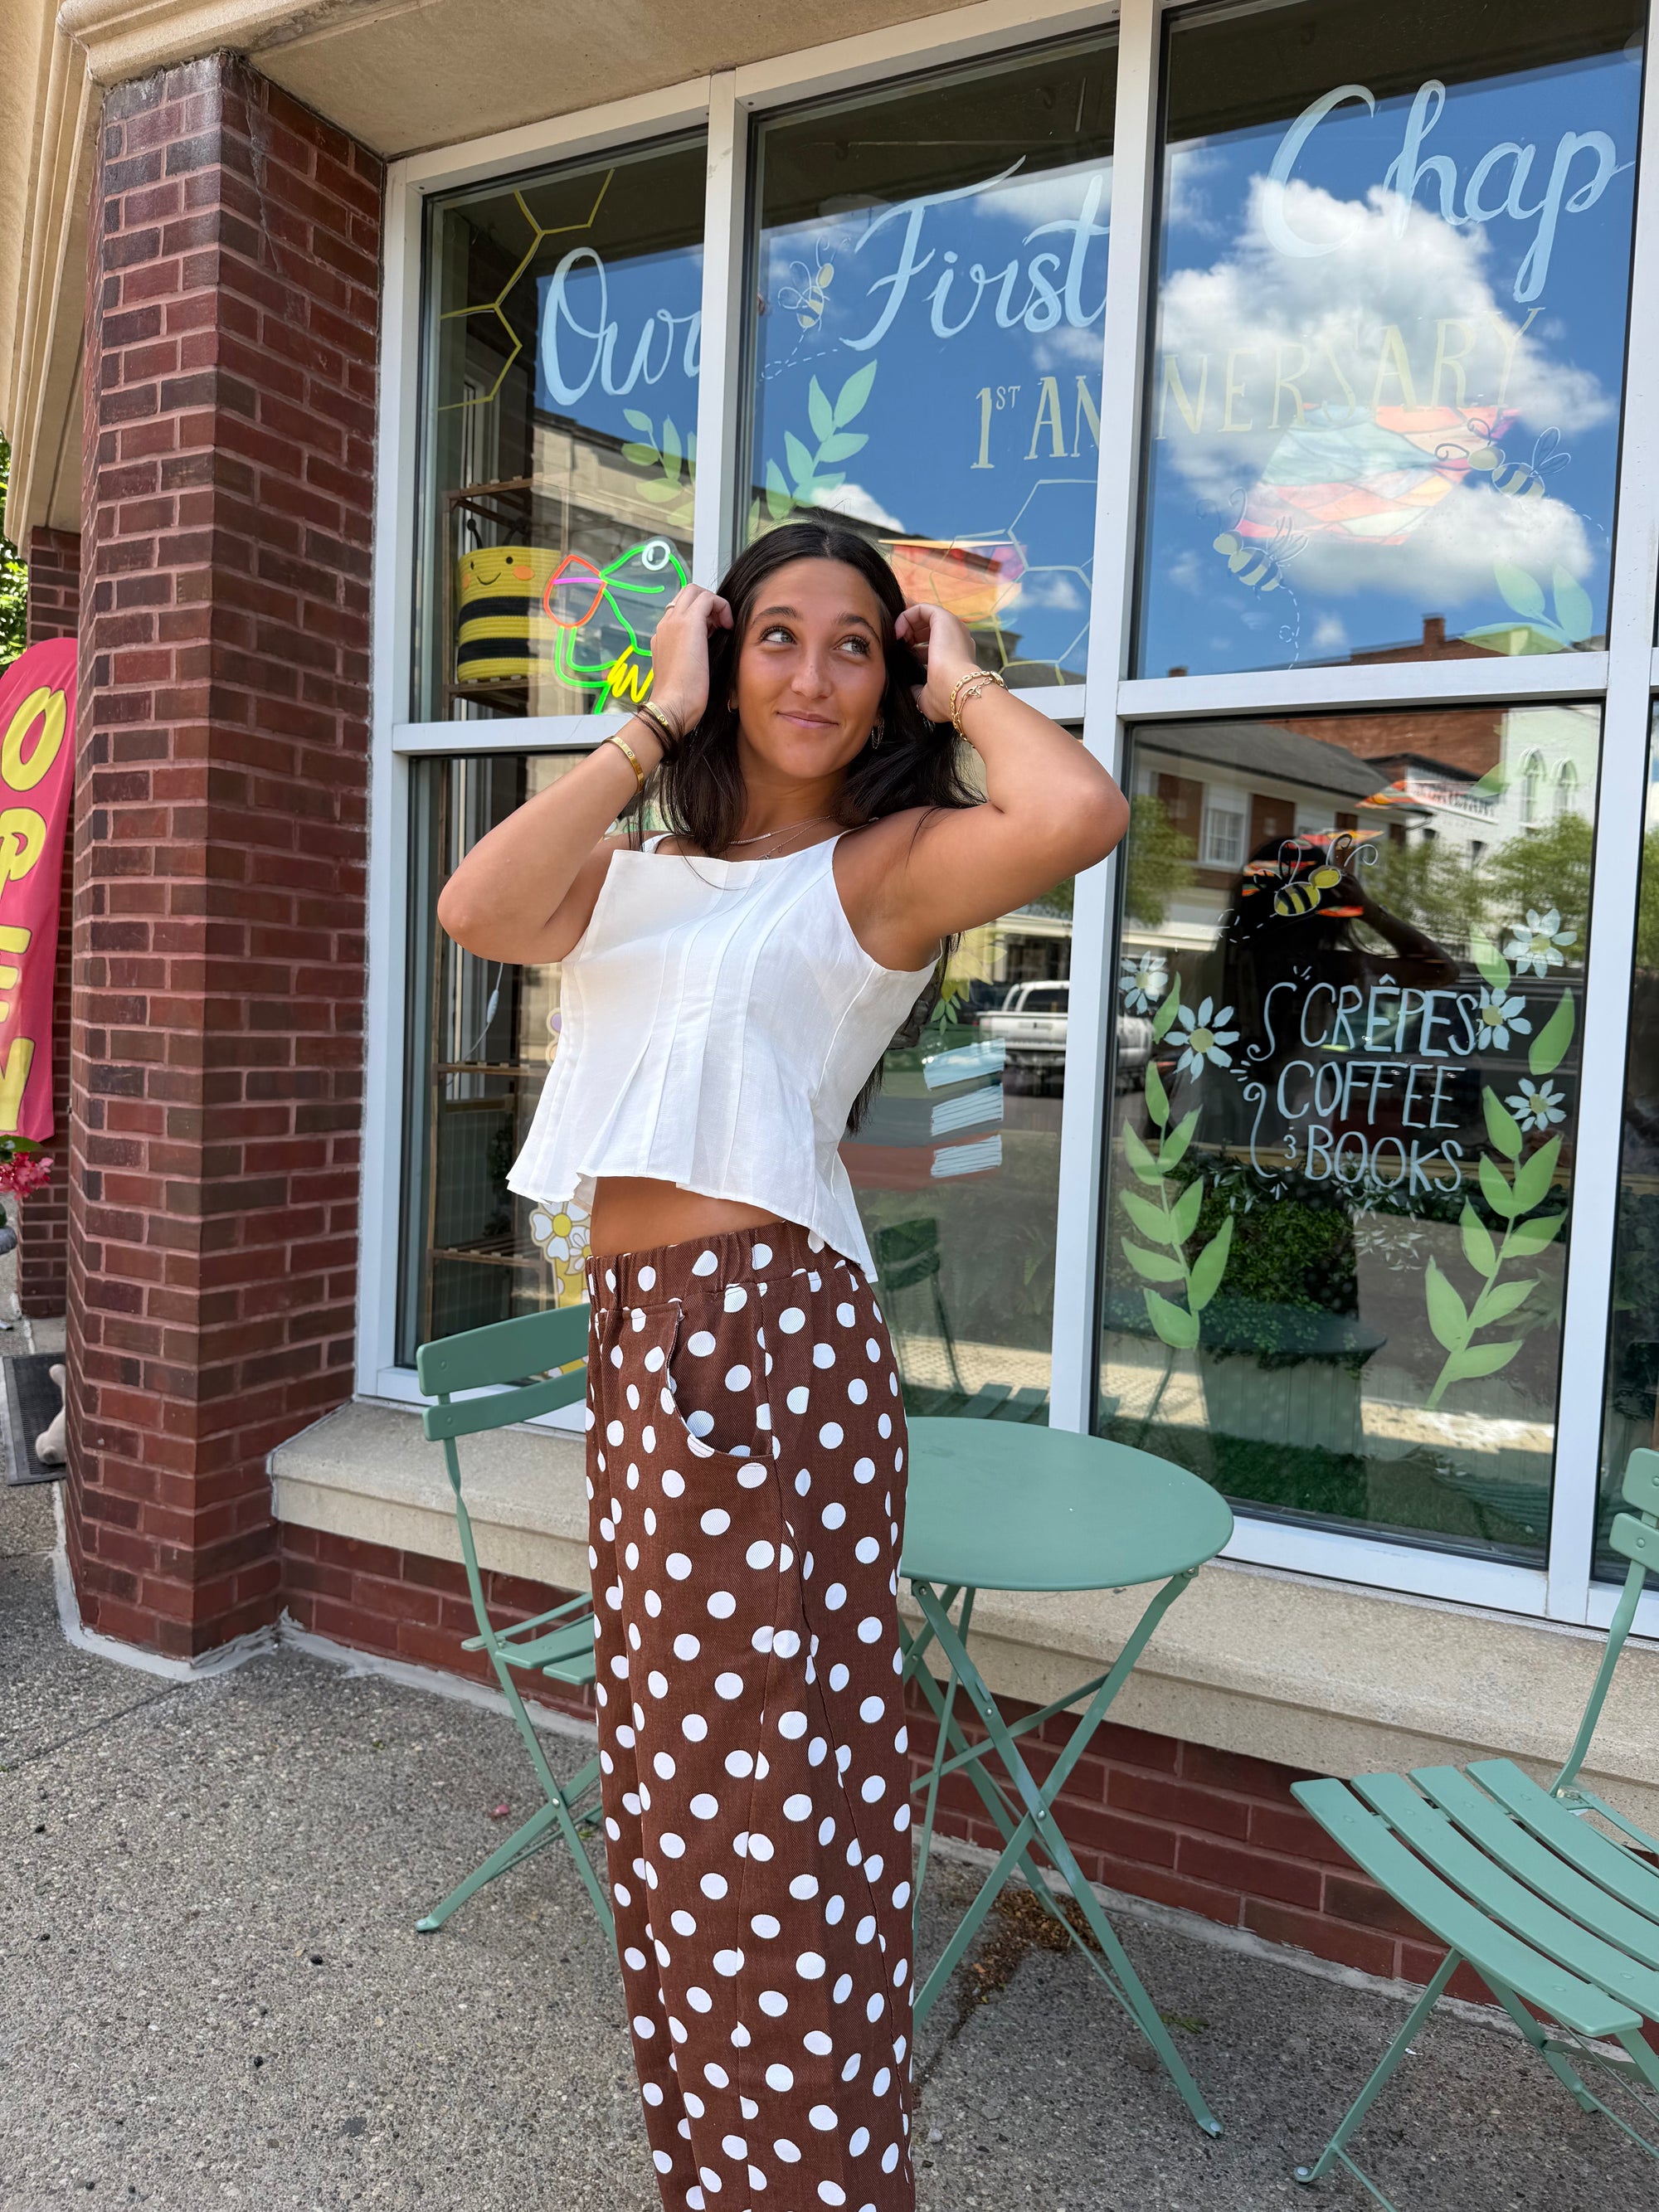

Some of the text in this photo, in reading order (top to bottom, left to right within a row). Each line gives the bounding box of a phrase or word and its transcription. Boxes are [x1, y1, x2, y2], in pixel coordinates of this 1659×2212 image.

[840, 155, 1110, 351] First
[1263, 79, 1635, 304] Chap
[1277, 1061, 1467, 1129] COFFEE
[1304, 1124, 1463, 1196] BOOKS
